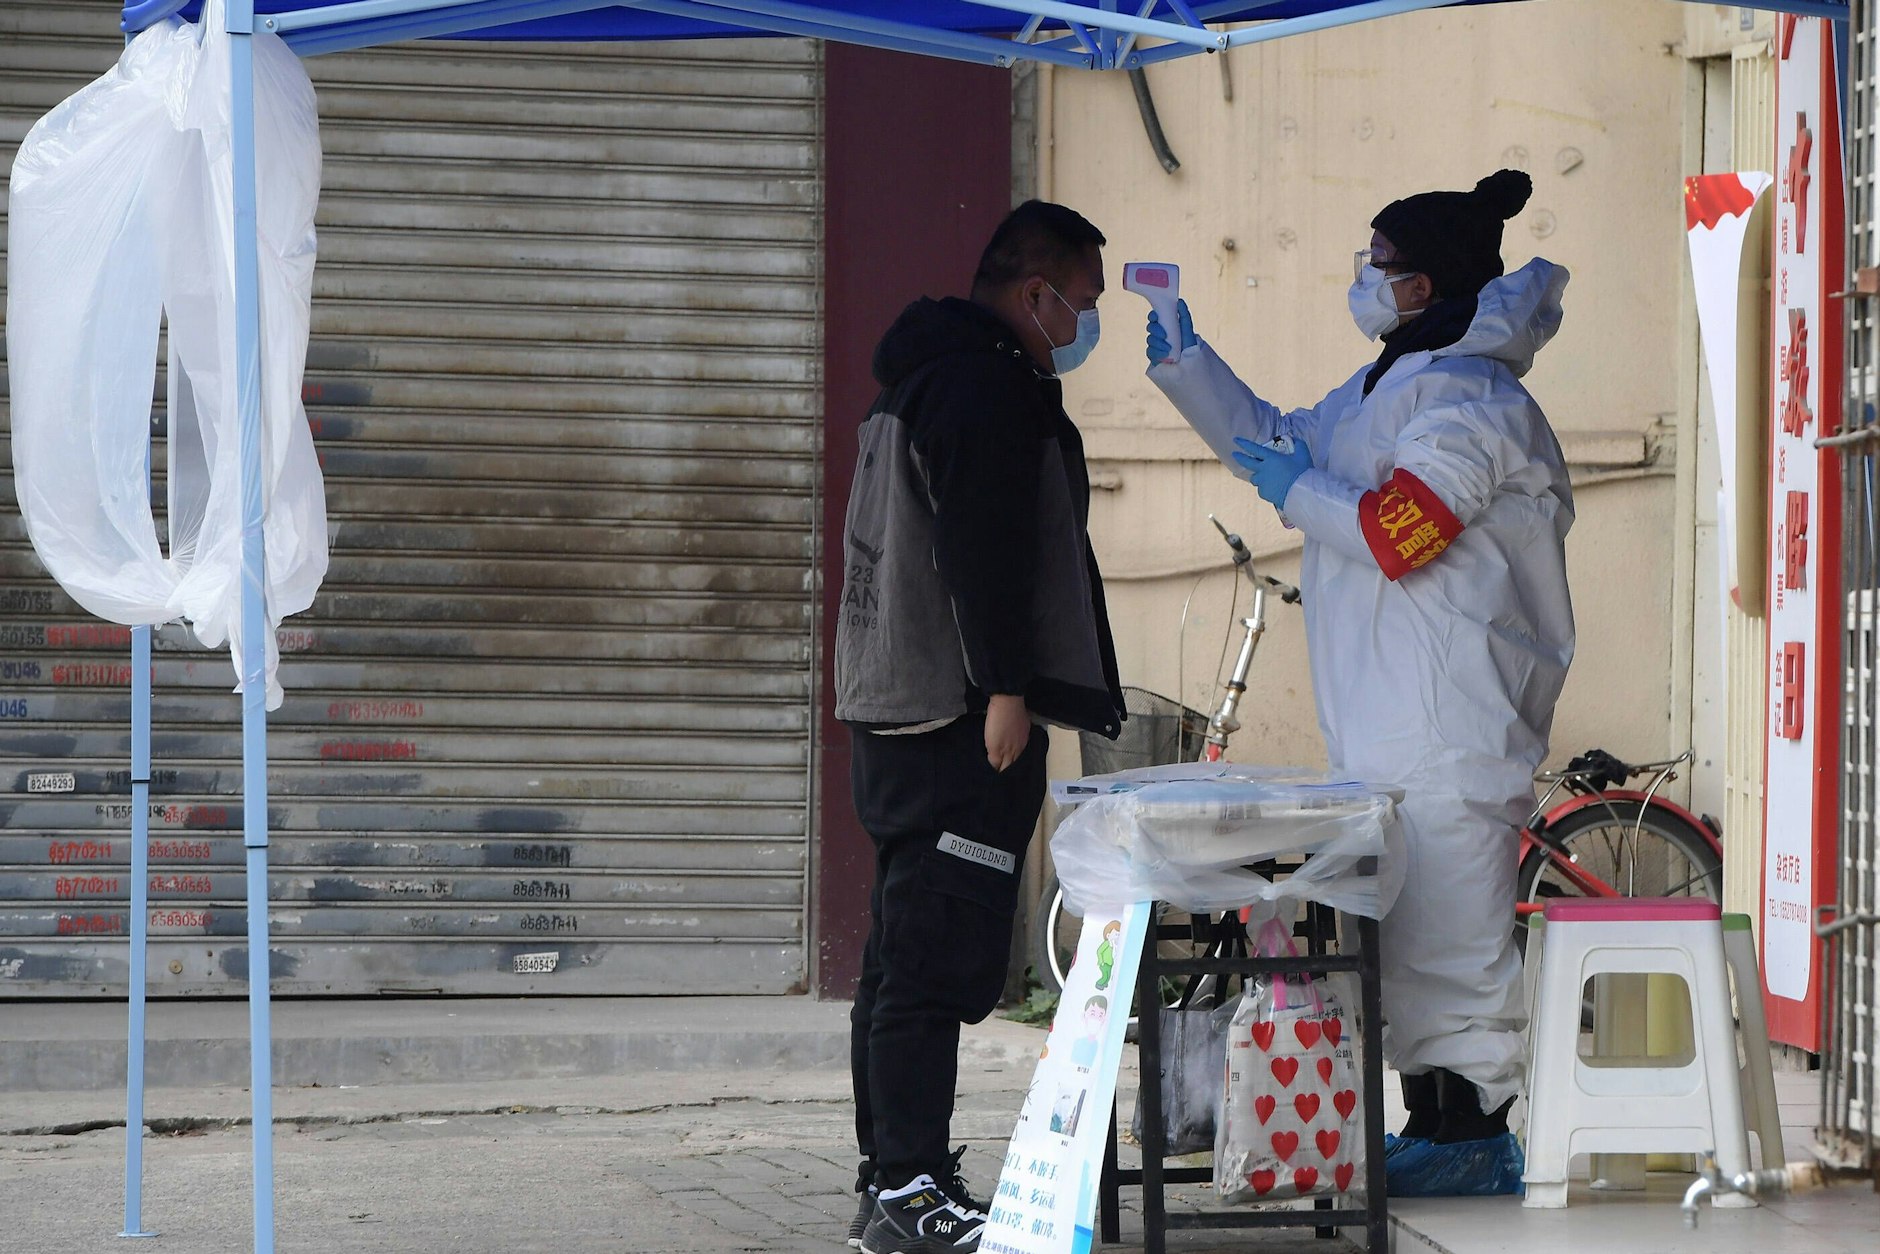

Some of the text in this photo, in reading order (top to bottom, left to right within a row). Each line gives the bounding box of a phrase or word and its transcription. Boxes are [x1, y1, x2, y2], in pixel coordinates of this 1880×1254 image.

[850, 565, 874, 584] 23
[31, 778, 74, 790] 82449293
[1776, 852, 1801, 884] 杂技厅店
[56, 875, 119, 895] 85770211
